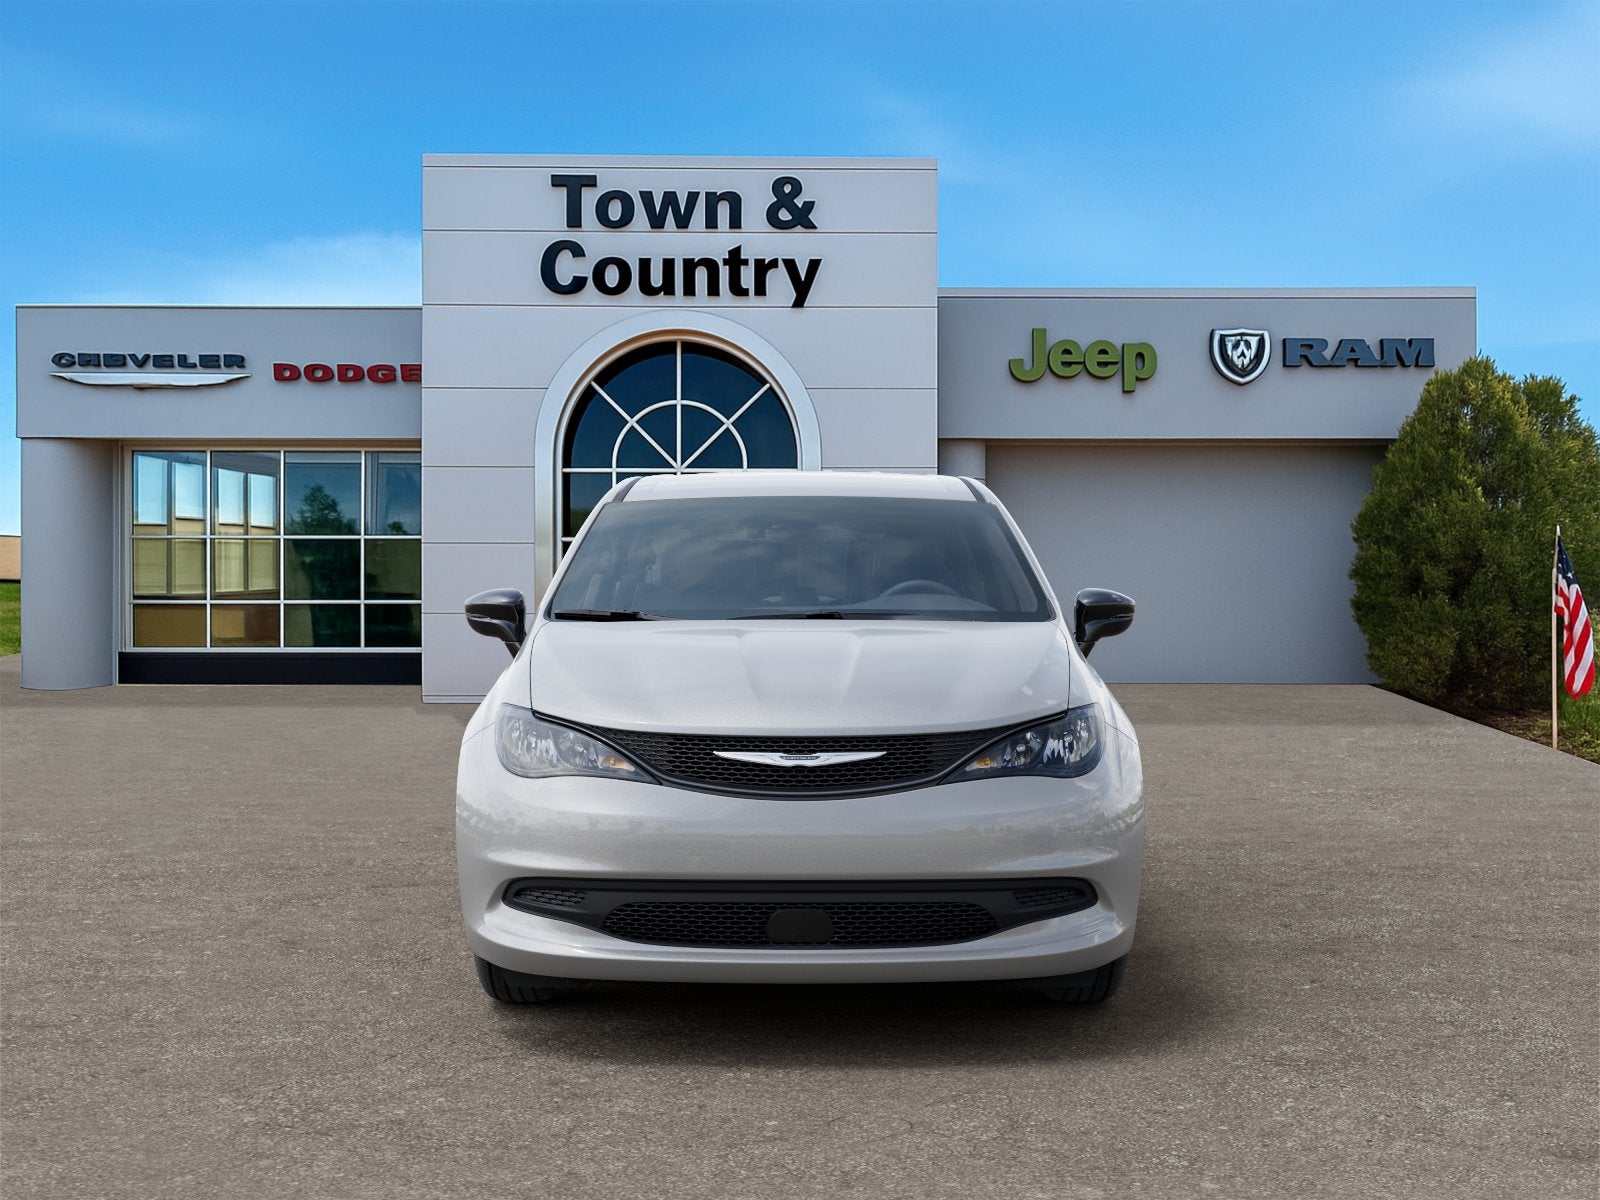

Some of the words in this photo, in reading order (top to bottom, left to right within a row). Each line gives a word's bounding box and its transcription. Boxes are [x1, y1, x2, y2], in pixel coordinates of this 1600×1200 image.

[550, 174, 742, 229] Town
[766, 176, 817, 229] &
[540, 239, 822, 308] Country
[273, 363, 422, 383] DODGE
[1009, 328, 1157, 392] Jeep
[1283, 338, 1435, 367] RAM
